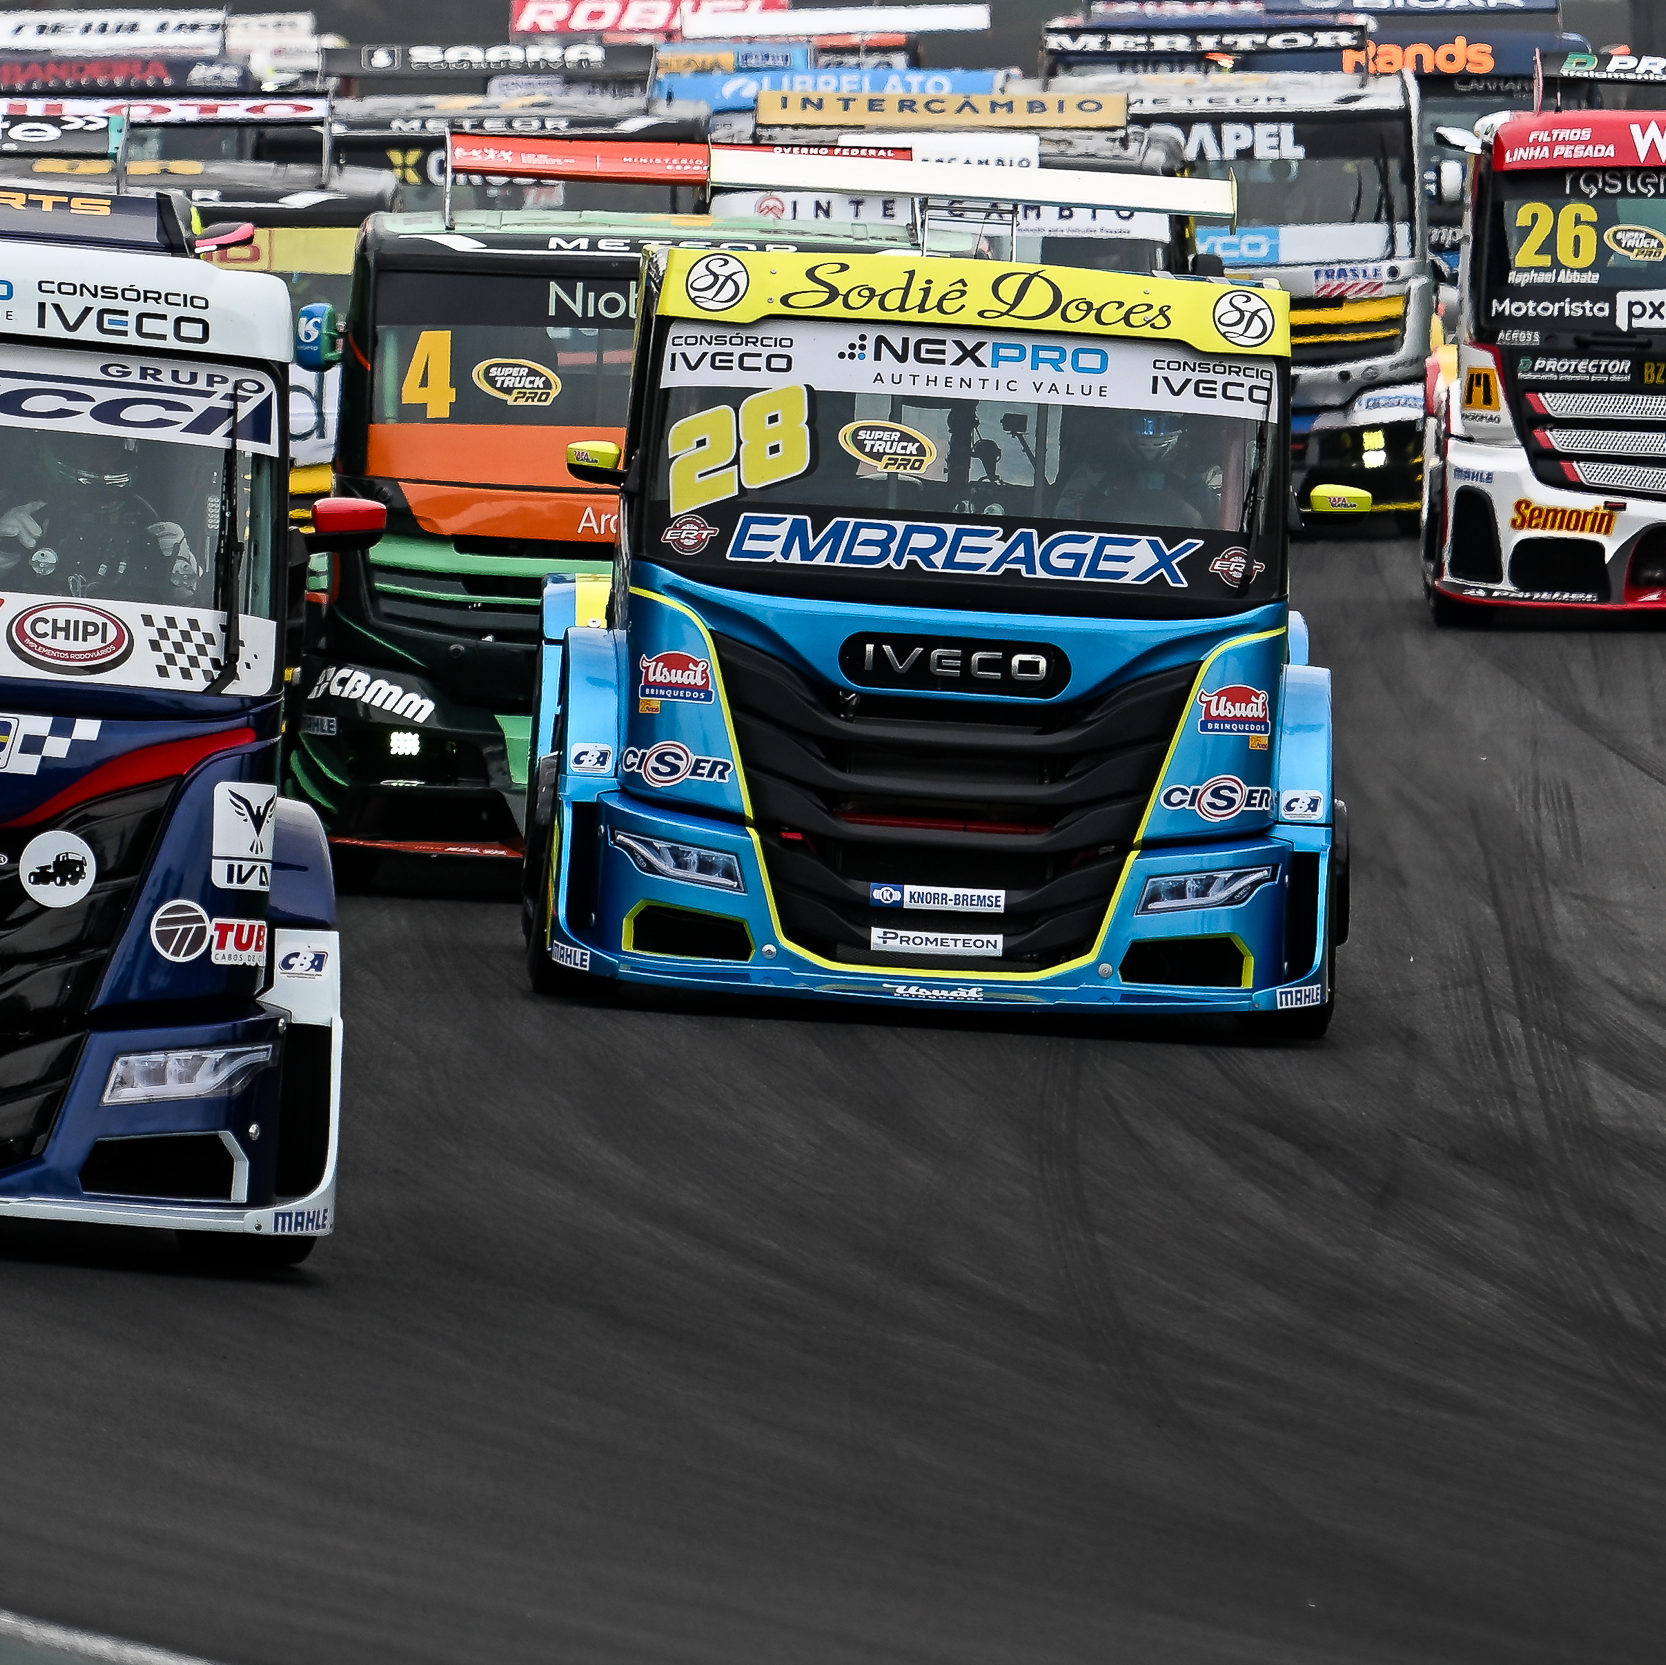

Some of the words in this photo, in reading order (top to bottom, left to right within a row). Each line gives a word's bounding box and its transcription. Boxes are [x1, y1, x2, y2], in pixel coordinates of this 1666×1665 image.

[1047, 31, 1360, 52] MERITOR
[780, 94, 1103, 115] INTERCÂMBIO
[1528, 127, 1593, 142] FILTROS
[773, 146, 830, 155] OVERNO
[834, 148, 895, 157] FEDERAL
[1504, 144, 1550, 162] LINHA
[1553, 143, 1616, 159] PESADA
[1514, 202, 1598, 268] 26
[1616, 230, 1646, 240] SUPER
[1621, 238, 1660, 249] TRUCK
[1634, 248, 1662, 259] PRO
[1508, 269, 1556, 286] Raphael
[1557, 269, 1600, 284] Abbate
[37, 280, 210, 310] CONSÓRCIO
[780, 262, 966, 316] Sodiê
[978, 270, 1172, 330] Doces
[1491, 297, 1610, 318] Motorista
[1627, 300, 1666, 327] px
[37, 302, 210, 345] IVECO
[671, 332, 794, 349] CONSÓRCIO
[670, 351, 793, 373] IVECO
[873, 334, 1109, 375] NEXPRO
[1534, 357, 1631, 373] PROTECTOR
[99, 363, 266, 397] GRUPO
[402, 330, 456, 419] 4
[489, 366, 529, 377] SUPER
[1152, 359, 1273, 381] CONSÓRCIO
[1644, 363, 1665, 384] BZ
[494, 376, 545, 389] TRUCK
[872, 372, 1018, 393] AUTHENTIC
[1032, 381, 1108, 398] VALUE
[1151, 376, 1271, 405] IVECO
[513, 390, 551, 403] PRO
[857, 430, 900, 442] SUPER
[669, 384, 810, 517] 28
[863, 440, 919, 455] TRUCK
[882, 457, 924, 472] PRO
[1454, 467, 1494, 483] MAHLE
[1510, 498, 1617, 536] Semorin
[727, 514, 1204, 588] EMBREAGEX
[30, 617, 109, 645] CHIPI
[25, 638, 69, 660] IMPLEMENTOS
[641, 653, 711, 686] Usual
[864, 643, 1047, 681] IVECO
[329, 667, 435, 724] CBMM
[645, 688, 706, 699] BRINQUEDOS
[1200, 688, 1267, 719] Usual
[1208, 721, 1266, 732] BRINQUEDOS
[572, 749, 610, 767] CBA
[623, 741, 732, 787] CISER
[1284, 794, 1321, 813] CBA
[909, 890, 1002, 908] KNORR-BREMSE
[877, 931, 998, 950] PROMETEON
[279, 950, 328, 974] CBA
[552, 944, 589, 969] MAHLE
[1279, 986, 1321, 1007] MAHLE
[273, 1208, 329, 1232] MAHLE
